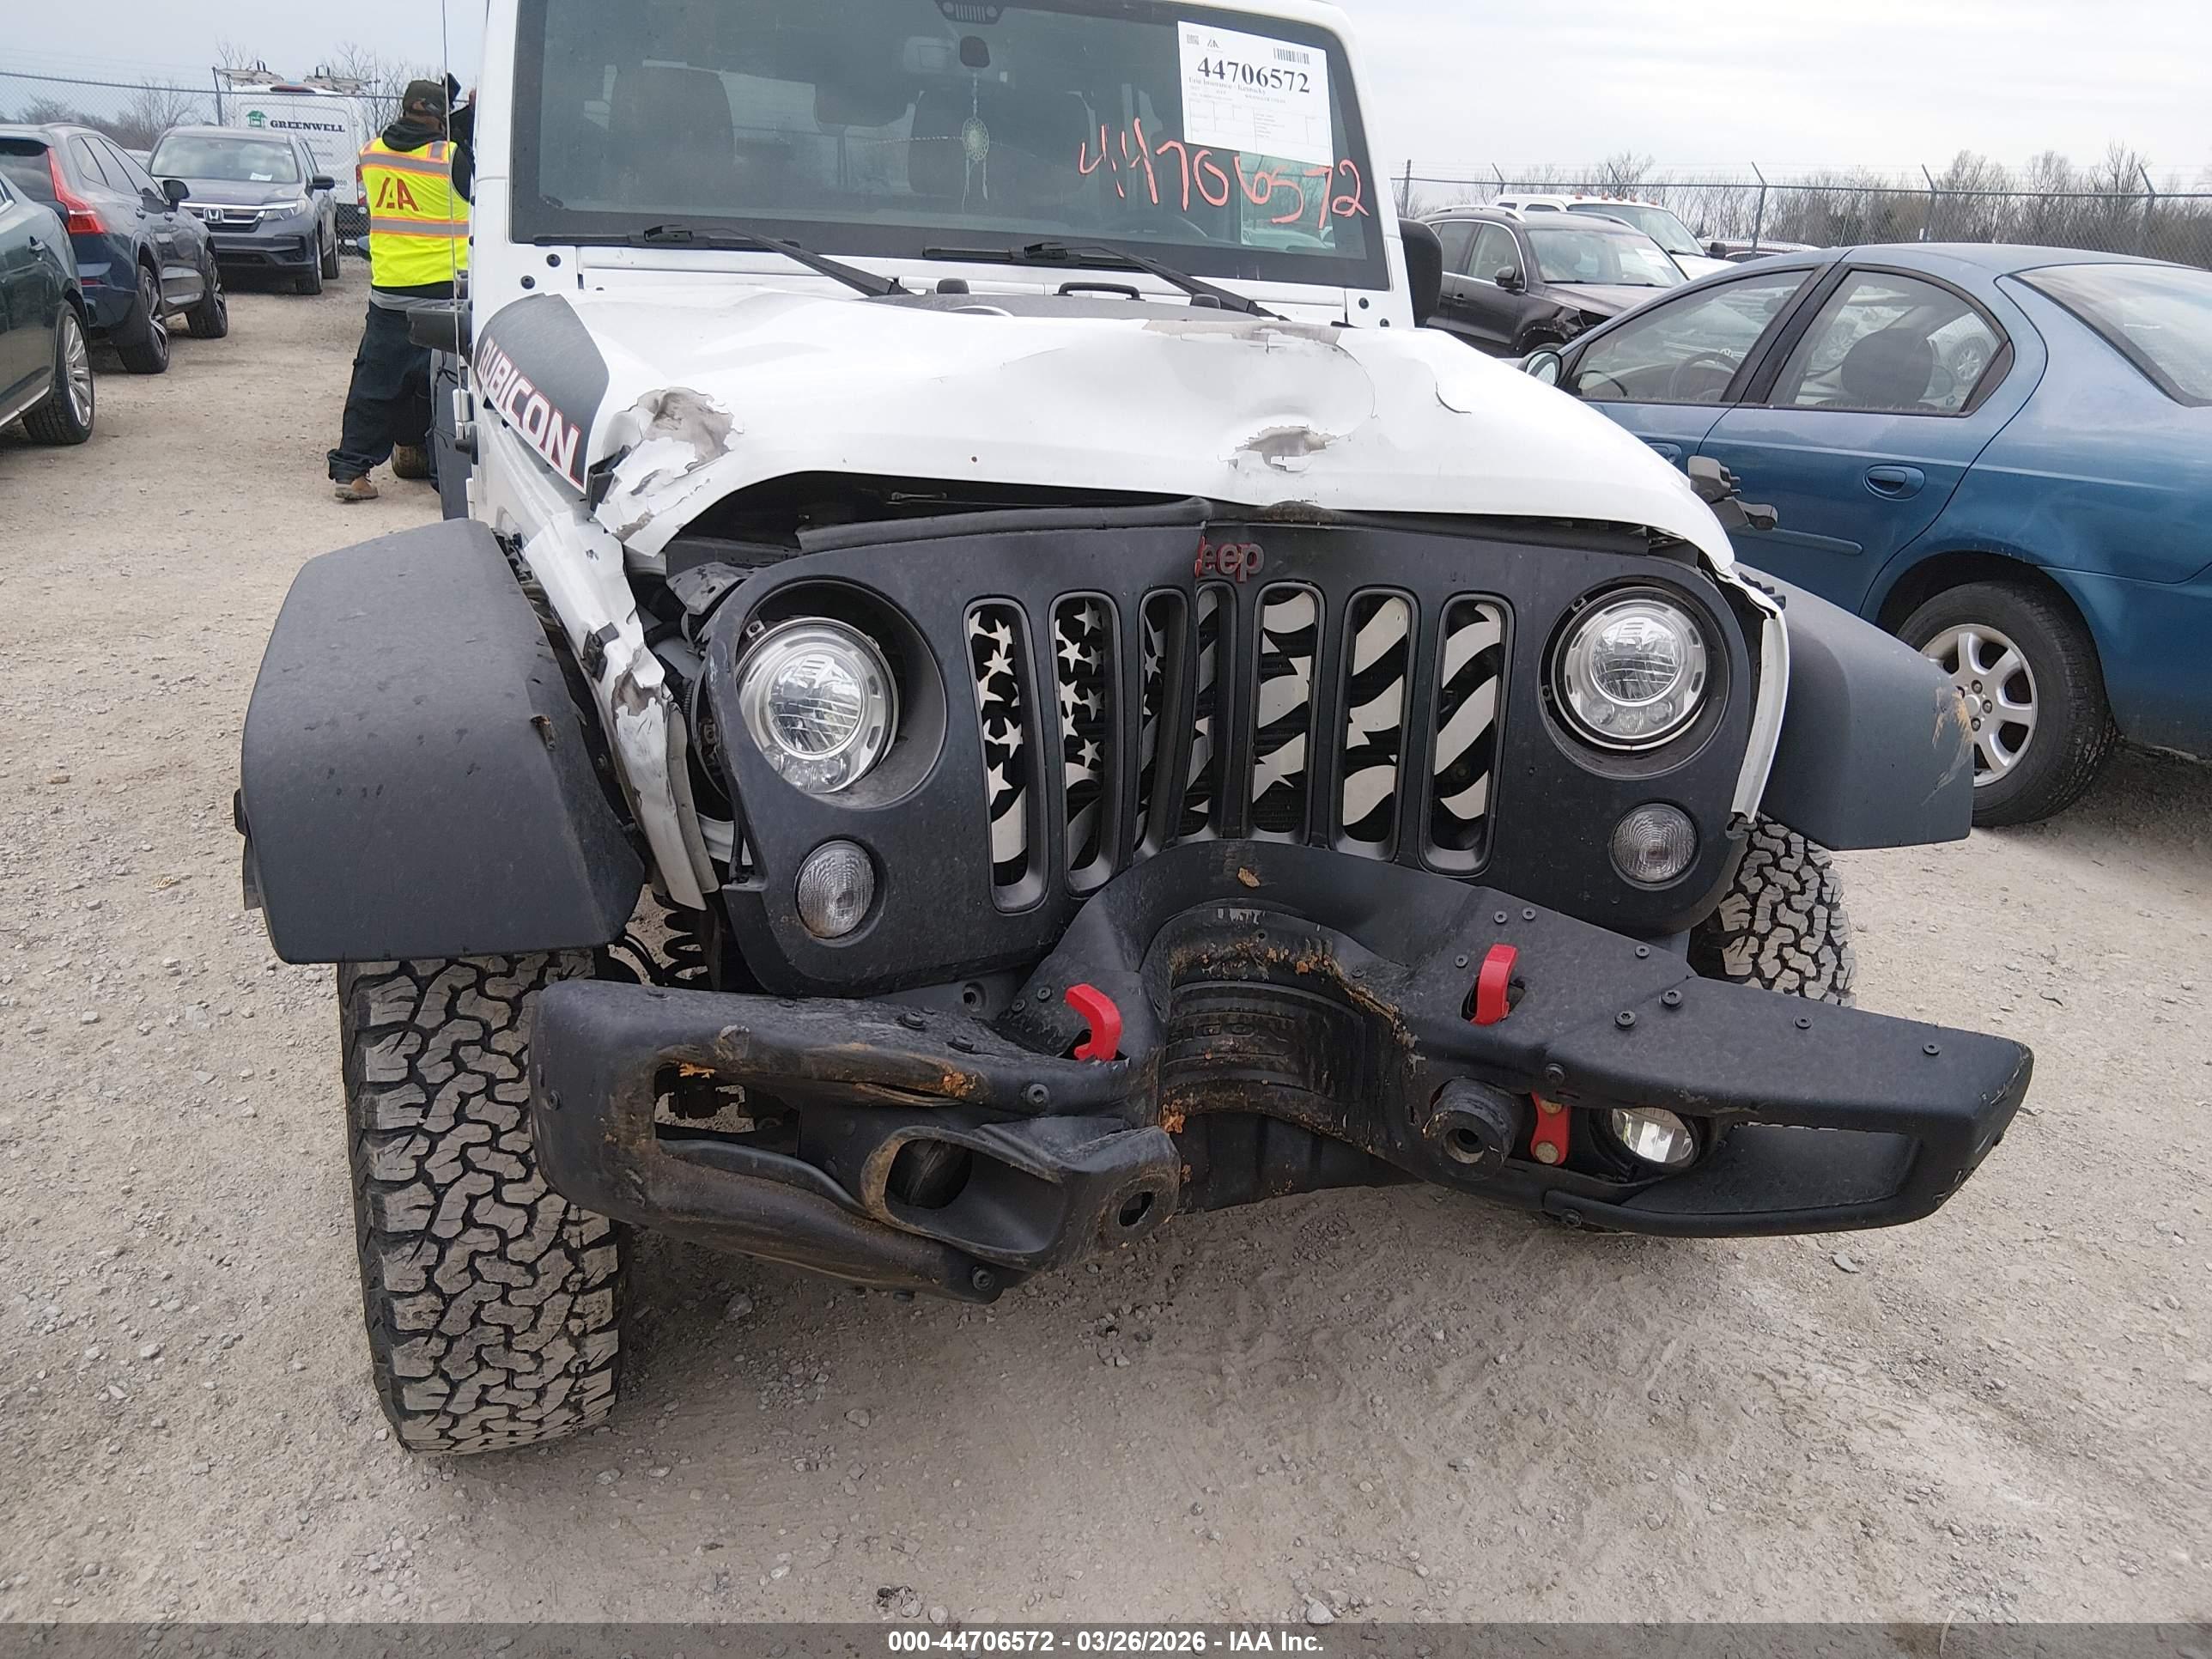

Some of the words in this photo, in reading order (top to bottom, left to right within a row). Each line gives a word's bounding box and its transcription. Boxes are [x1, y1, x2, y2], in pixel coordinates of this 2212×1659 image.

[1197, 57, 1310, 94] 44706572
[270, 119, 345, 132] GREENWELL
[477, 336, 585, 489] RUBICON
